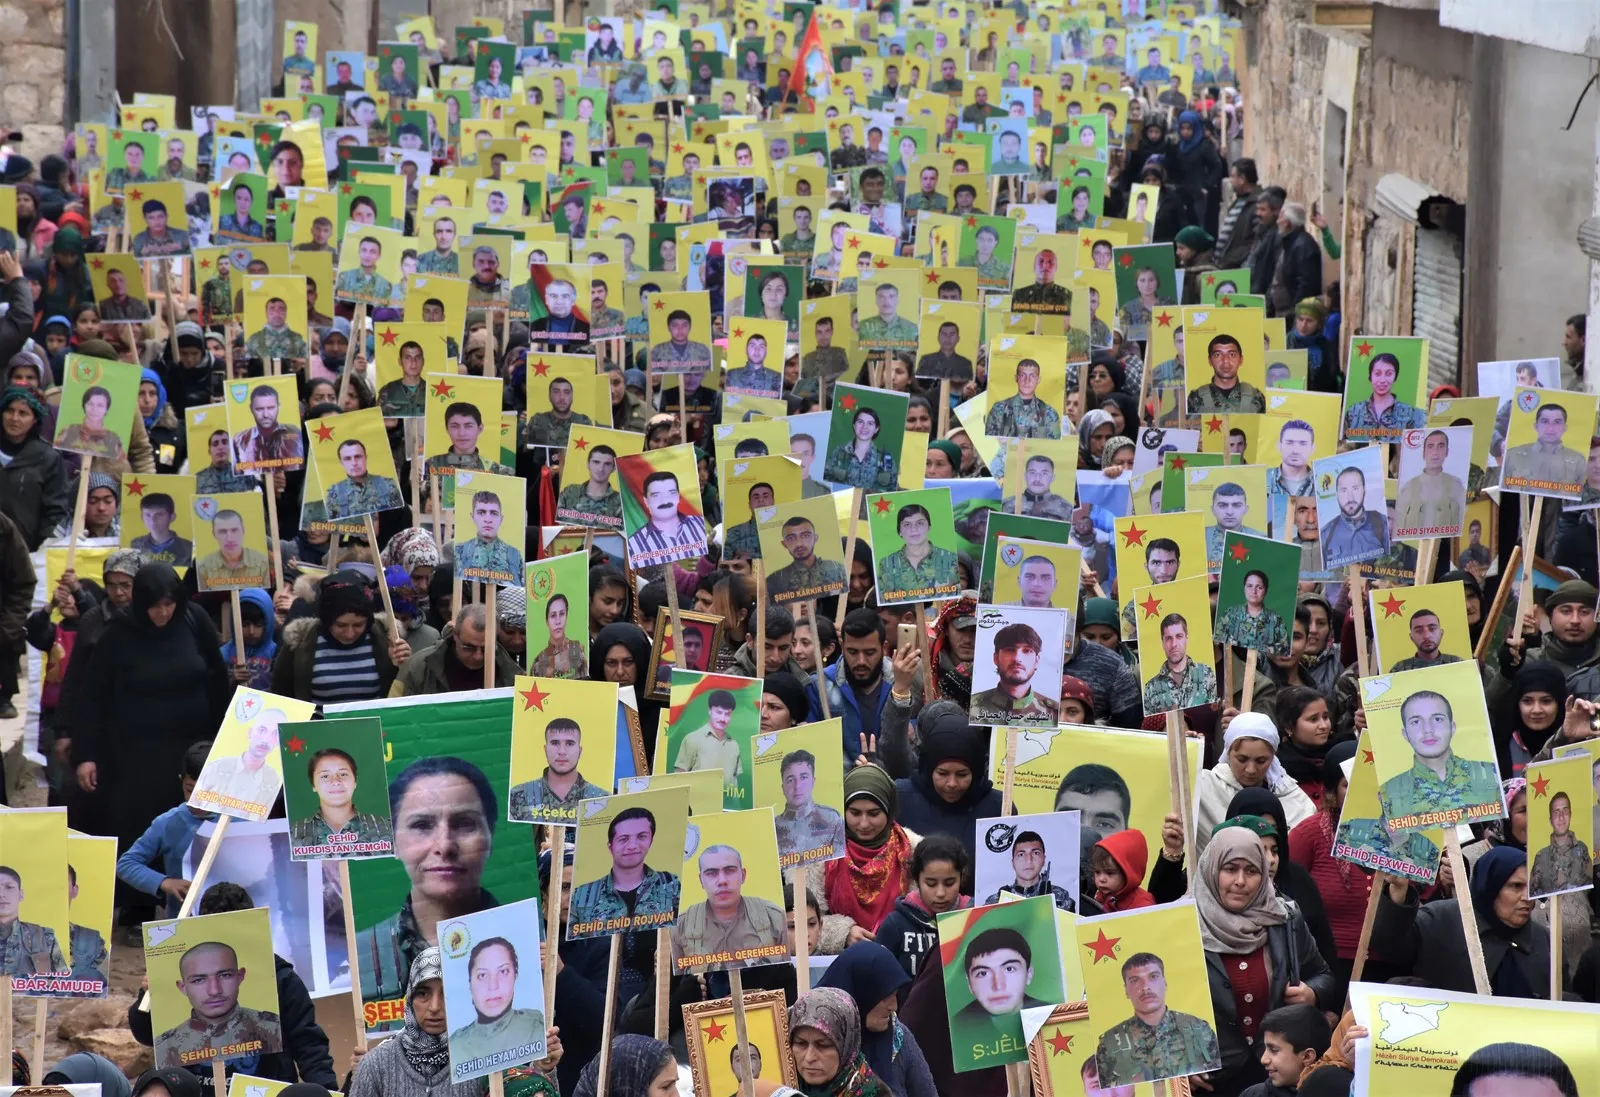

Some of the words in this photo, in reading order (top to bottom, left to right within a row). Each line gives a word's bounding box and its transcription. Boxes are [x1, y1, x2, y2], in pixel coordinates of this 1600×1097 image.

[1530, 480, 1561, 490] SERBEST
[531, 806, 578, 823] ş.çekd
[1420, 808, 1463, 827] ZERDEŞT
[1369, 850, 1433, 881] BEXWEDAN
[633, 910, 676, 926] ROJVAN
[50, 980, 104, 994] AMUDE
[364, 1000, 406, 1027] ŞEH
[221, 1040, 263, 1057] ESMER
[485, 1047, 517, 1066] HEYAM
[518, 1040, 544, 1059] OSKO
[971, 1033, 1026, 1061] Ş:JÊL
